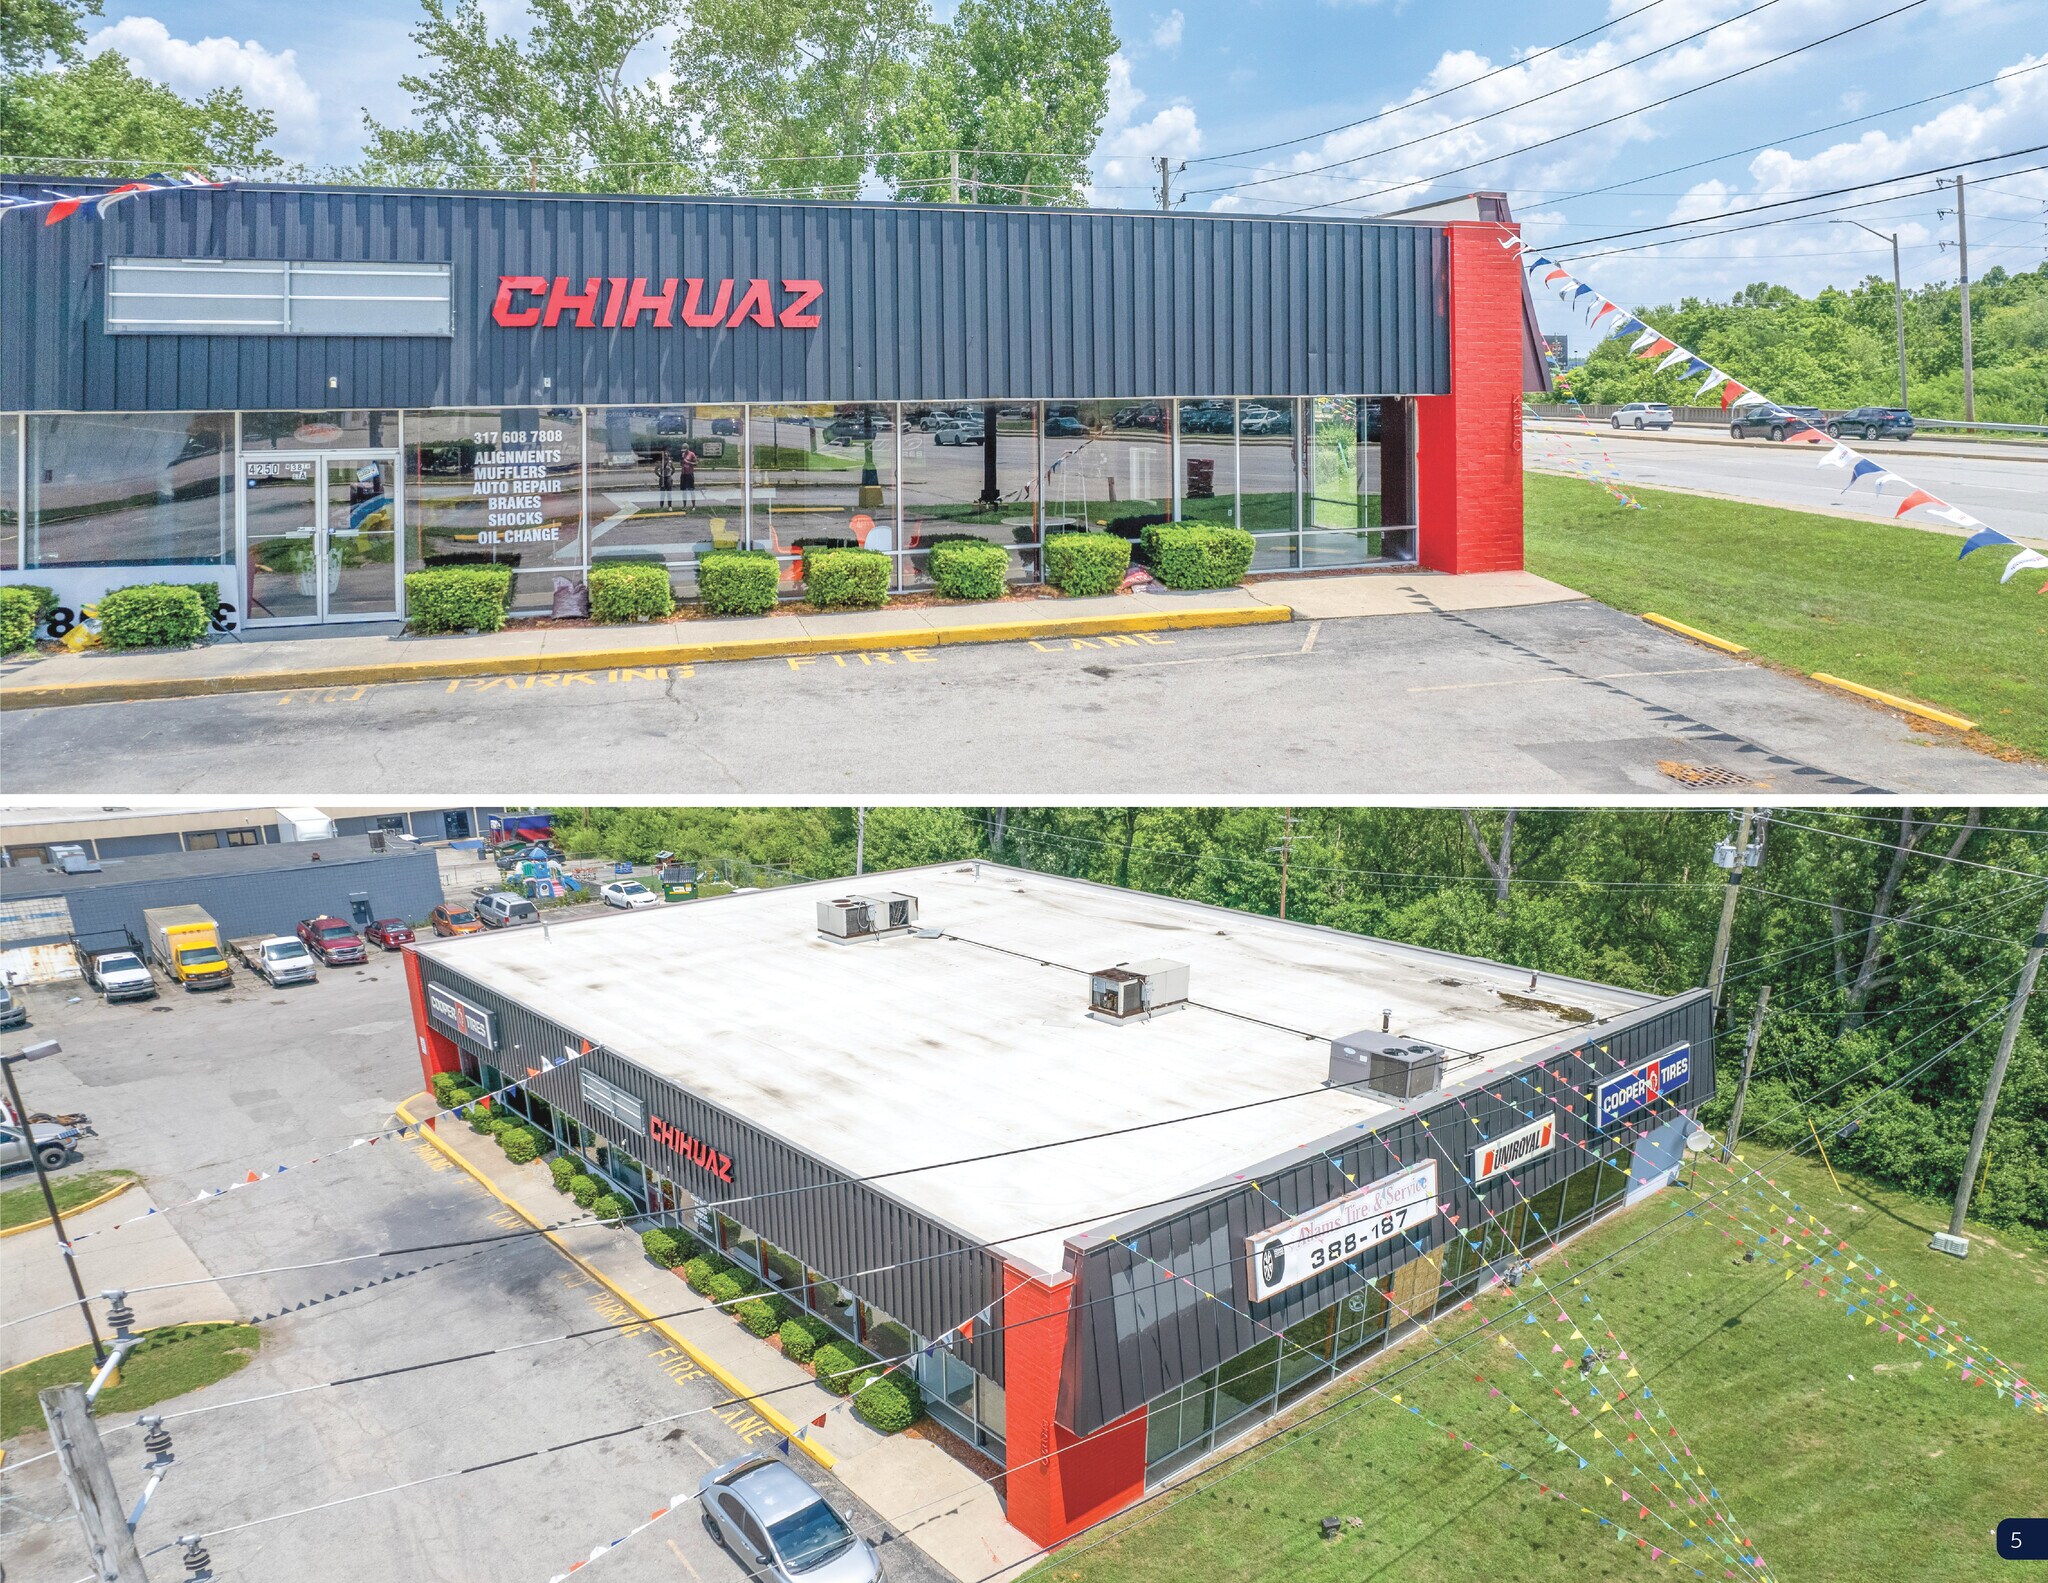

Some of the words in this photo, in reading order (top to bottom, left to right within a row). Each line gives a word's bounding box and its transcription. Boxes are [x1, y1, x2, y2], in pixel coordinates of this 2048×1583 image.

[492, 276, 824, 328] CHIHUAZ
[474, 431, 499, 444] 317
[502, 430, 527, 443] 608
[531, 430, 563, 443] 7808
[474, 450, 561, 465] ALIGNMENTS
[248, 464, 279, 475] 4250
[474, 466, 547, 480] MUFFLERS
[473, 481, 509, 495] AUTO
[513, 480, 561, 494] REPAIR
[488, 496, 542, 511] BRAKES
[488, 512, 543, 527] SHOCKS
[478, 530, 500, 545] OIL
[505, 528, 559, 544] CHANGE
[445, 665, 696, 694] PARKING
[786, 648, 939, 671] FIRE
[1028, 632, 1176, 653] LANE
[1603, 1079, 1647, 1114] COOPER
[1660, 1057, 1688, 1084] TIRES
[650, 1114, 733, 1184] CHIHUAZ
[1493, 1130, 1541, 1170] UNIROYAL
[1344, 1201, 1368, 1222] Tire
[1373, 1192, 1383, 1212] &
[1385, 1176, 1428, 1205] Service
[585, 1291, 651, 1339] PARKING
[648, 1346, 706, 1387] FIRE
[711, 1398, 777, 1445] LANE
